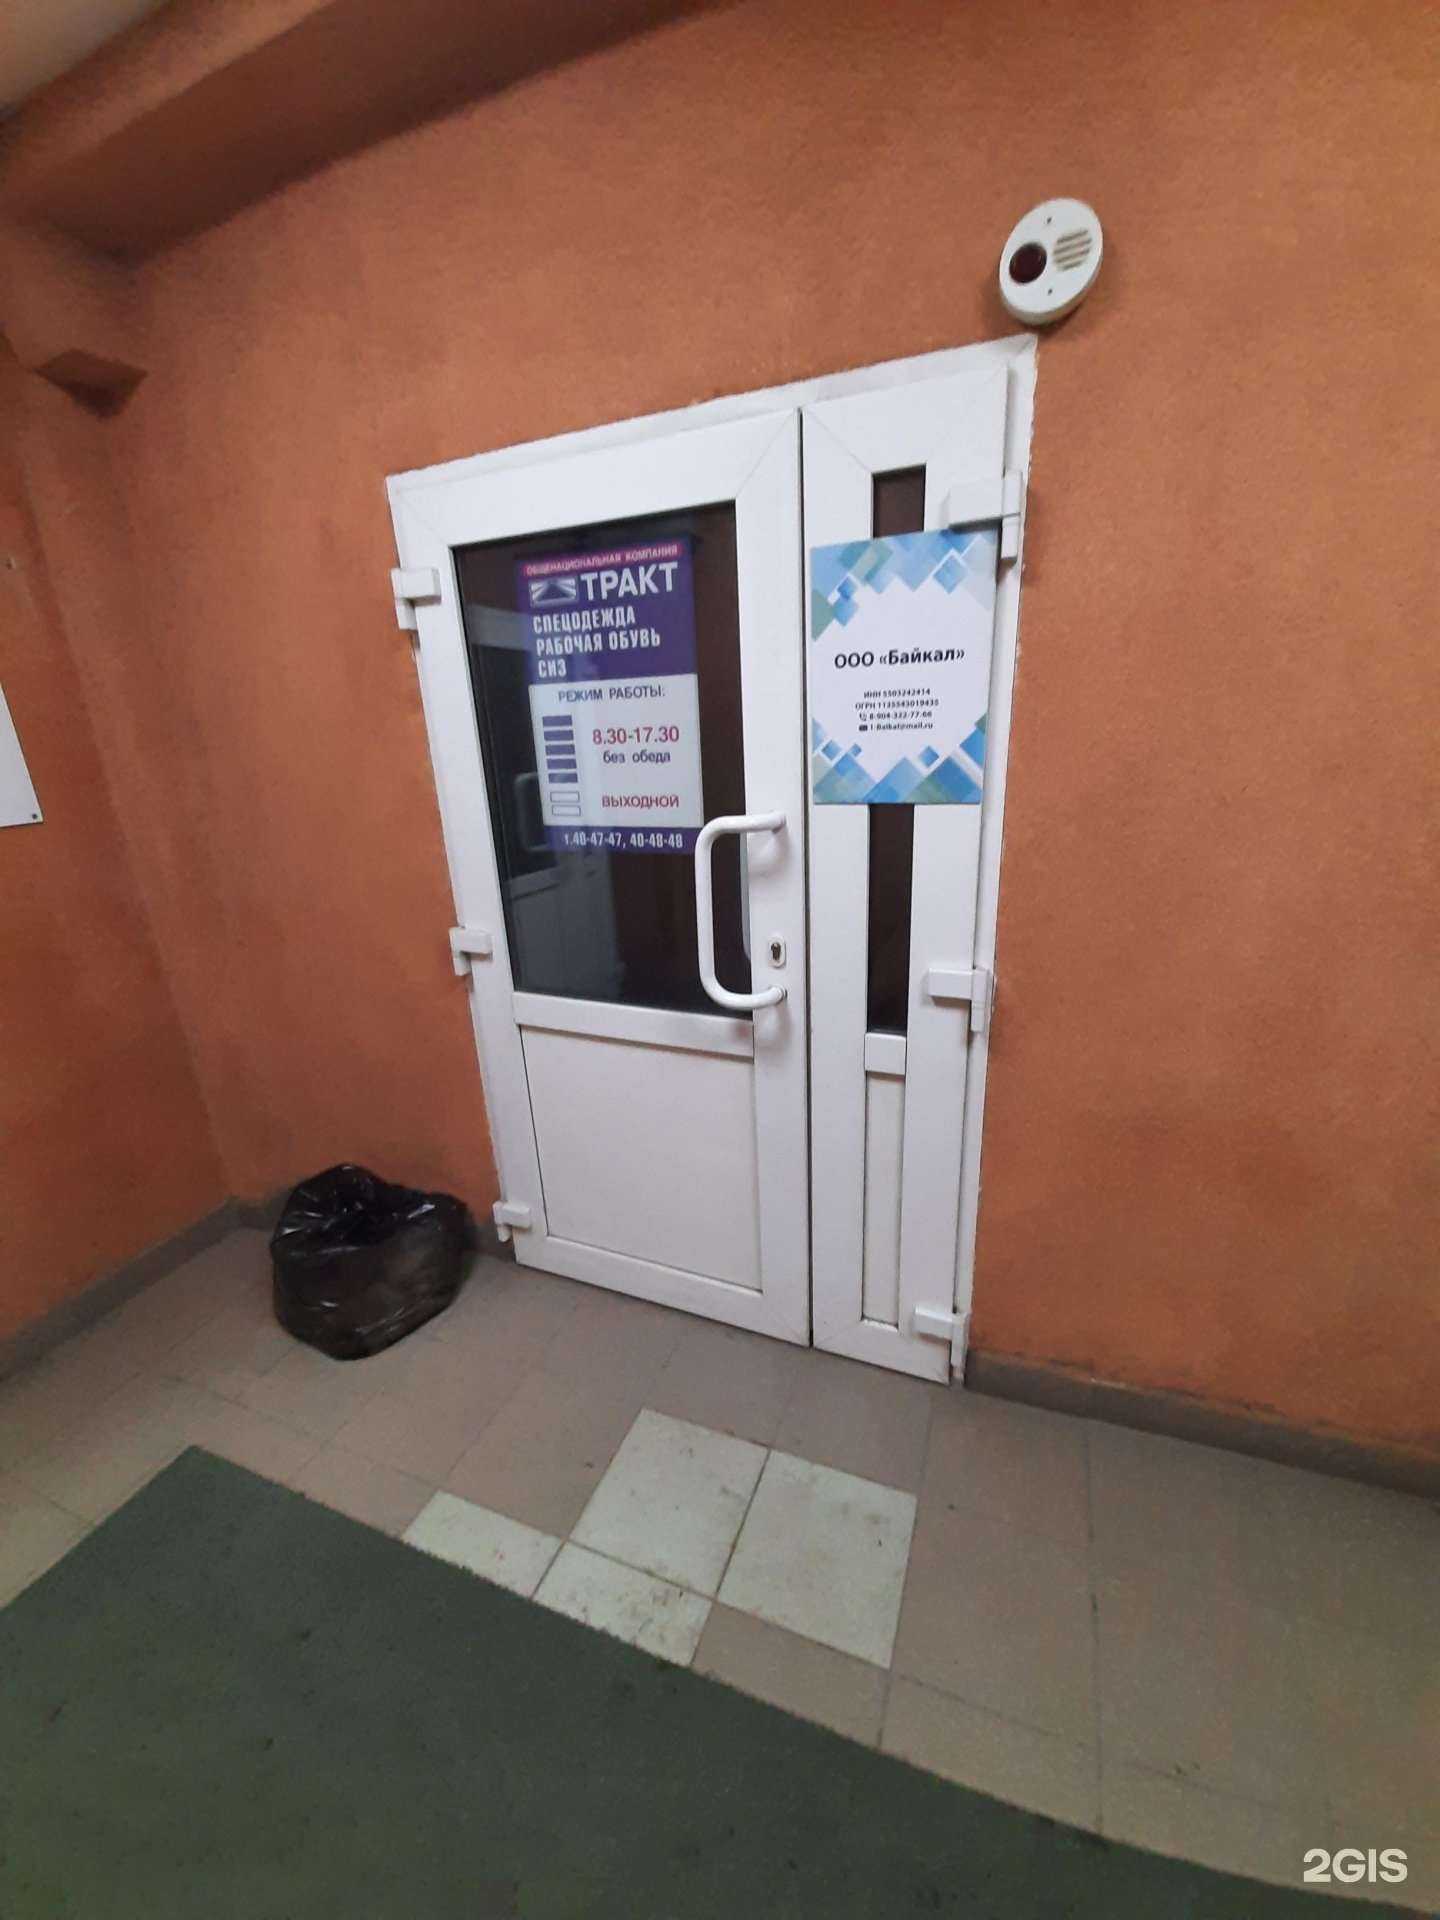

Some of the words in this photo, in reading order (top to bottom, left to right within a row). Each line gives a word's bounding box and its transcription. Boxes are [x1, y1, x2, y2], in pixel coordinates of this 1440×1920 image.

[625, 544, 678, 562] КОМПАНИЯ
[580, 562, 678, 601] ТРАКТ
[533, 605, 635, 634] СПЕЦОДЕЖДА
[536, 633, 602, 656] РАБОЧАЯ
[608, 628, 661, 650] ОБУВЬ
[834, 651, 875, 669] ООО
[879, 648, 965, 666] «Байкал»
[538, 658, 567, 678] СИЗ
[558, 688, 603, 702] РЕЖИМ
[609, 685, 666, 699] РАБОТЫ:
[863, 690, 881, 698] ИНН
[855, 702, 876, 710] ОГРН
[592, 726, 680, 745] 8.30-17.30
[603, 750, 625, 763] без
[632, 750, 671, 763] обеда
[602, 794, 680, 809] ВЫХОДНОЙ
